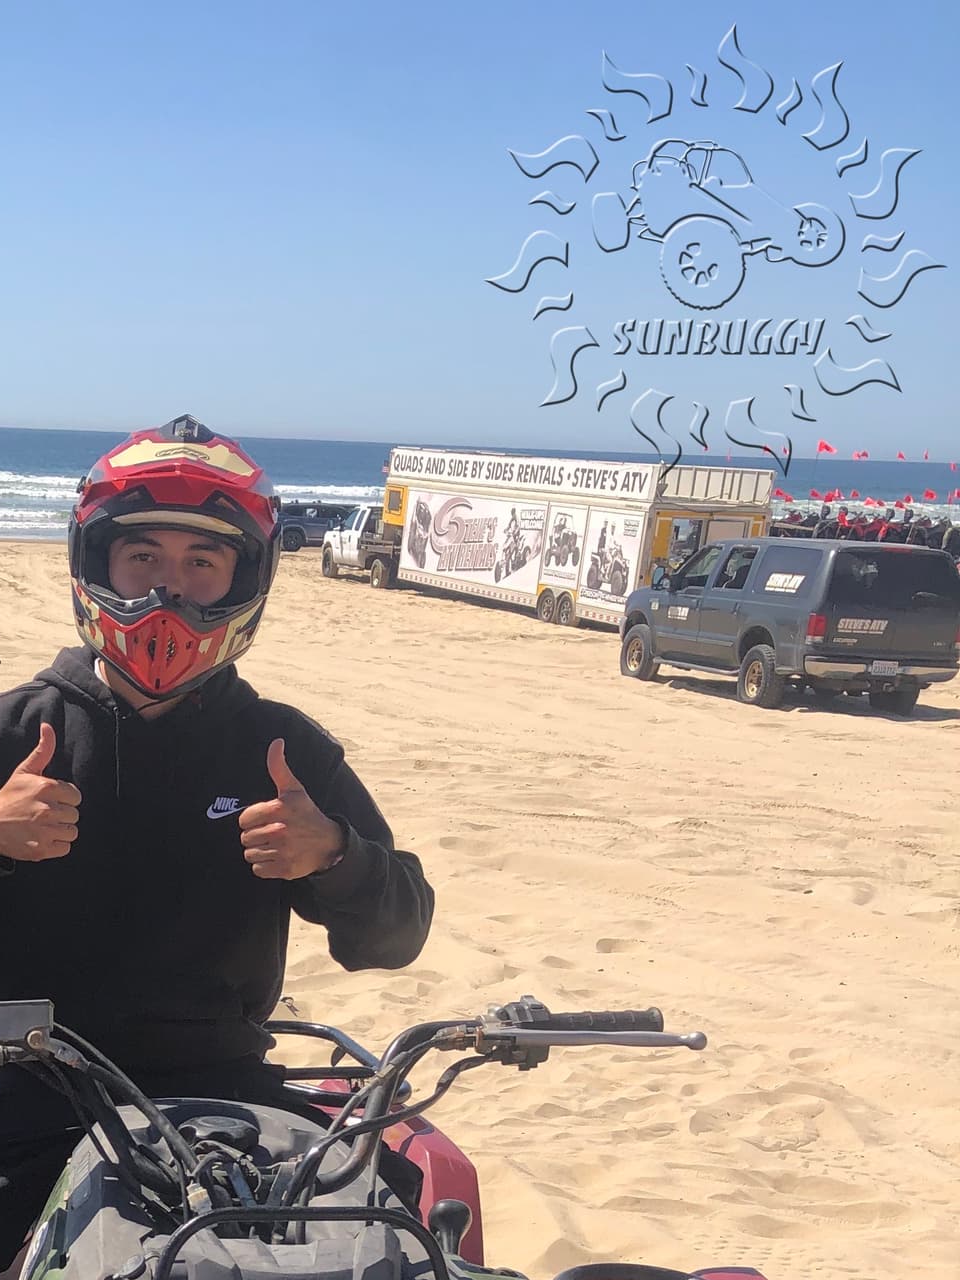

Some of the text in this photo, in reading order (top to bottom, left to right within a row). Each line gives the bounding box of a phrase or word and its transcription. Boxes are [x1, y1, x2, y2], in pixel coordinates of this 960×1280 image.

[393, 454, 648, 493] QUADS AND SIDE BY SIDES RENTALS STEVE'S ATV
[869, 619, 888, 631] ATV
[213, 796, 240, 811] NIKE
